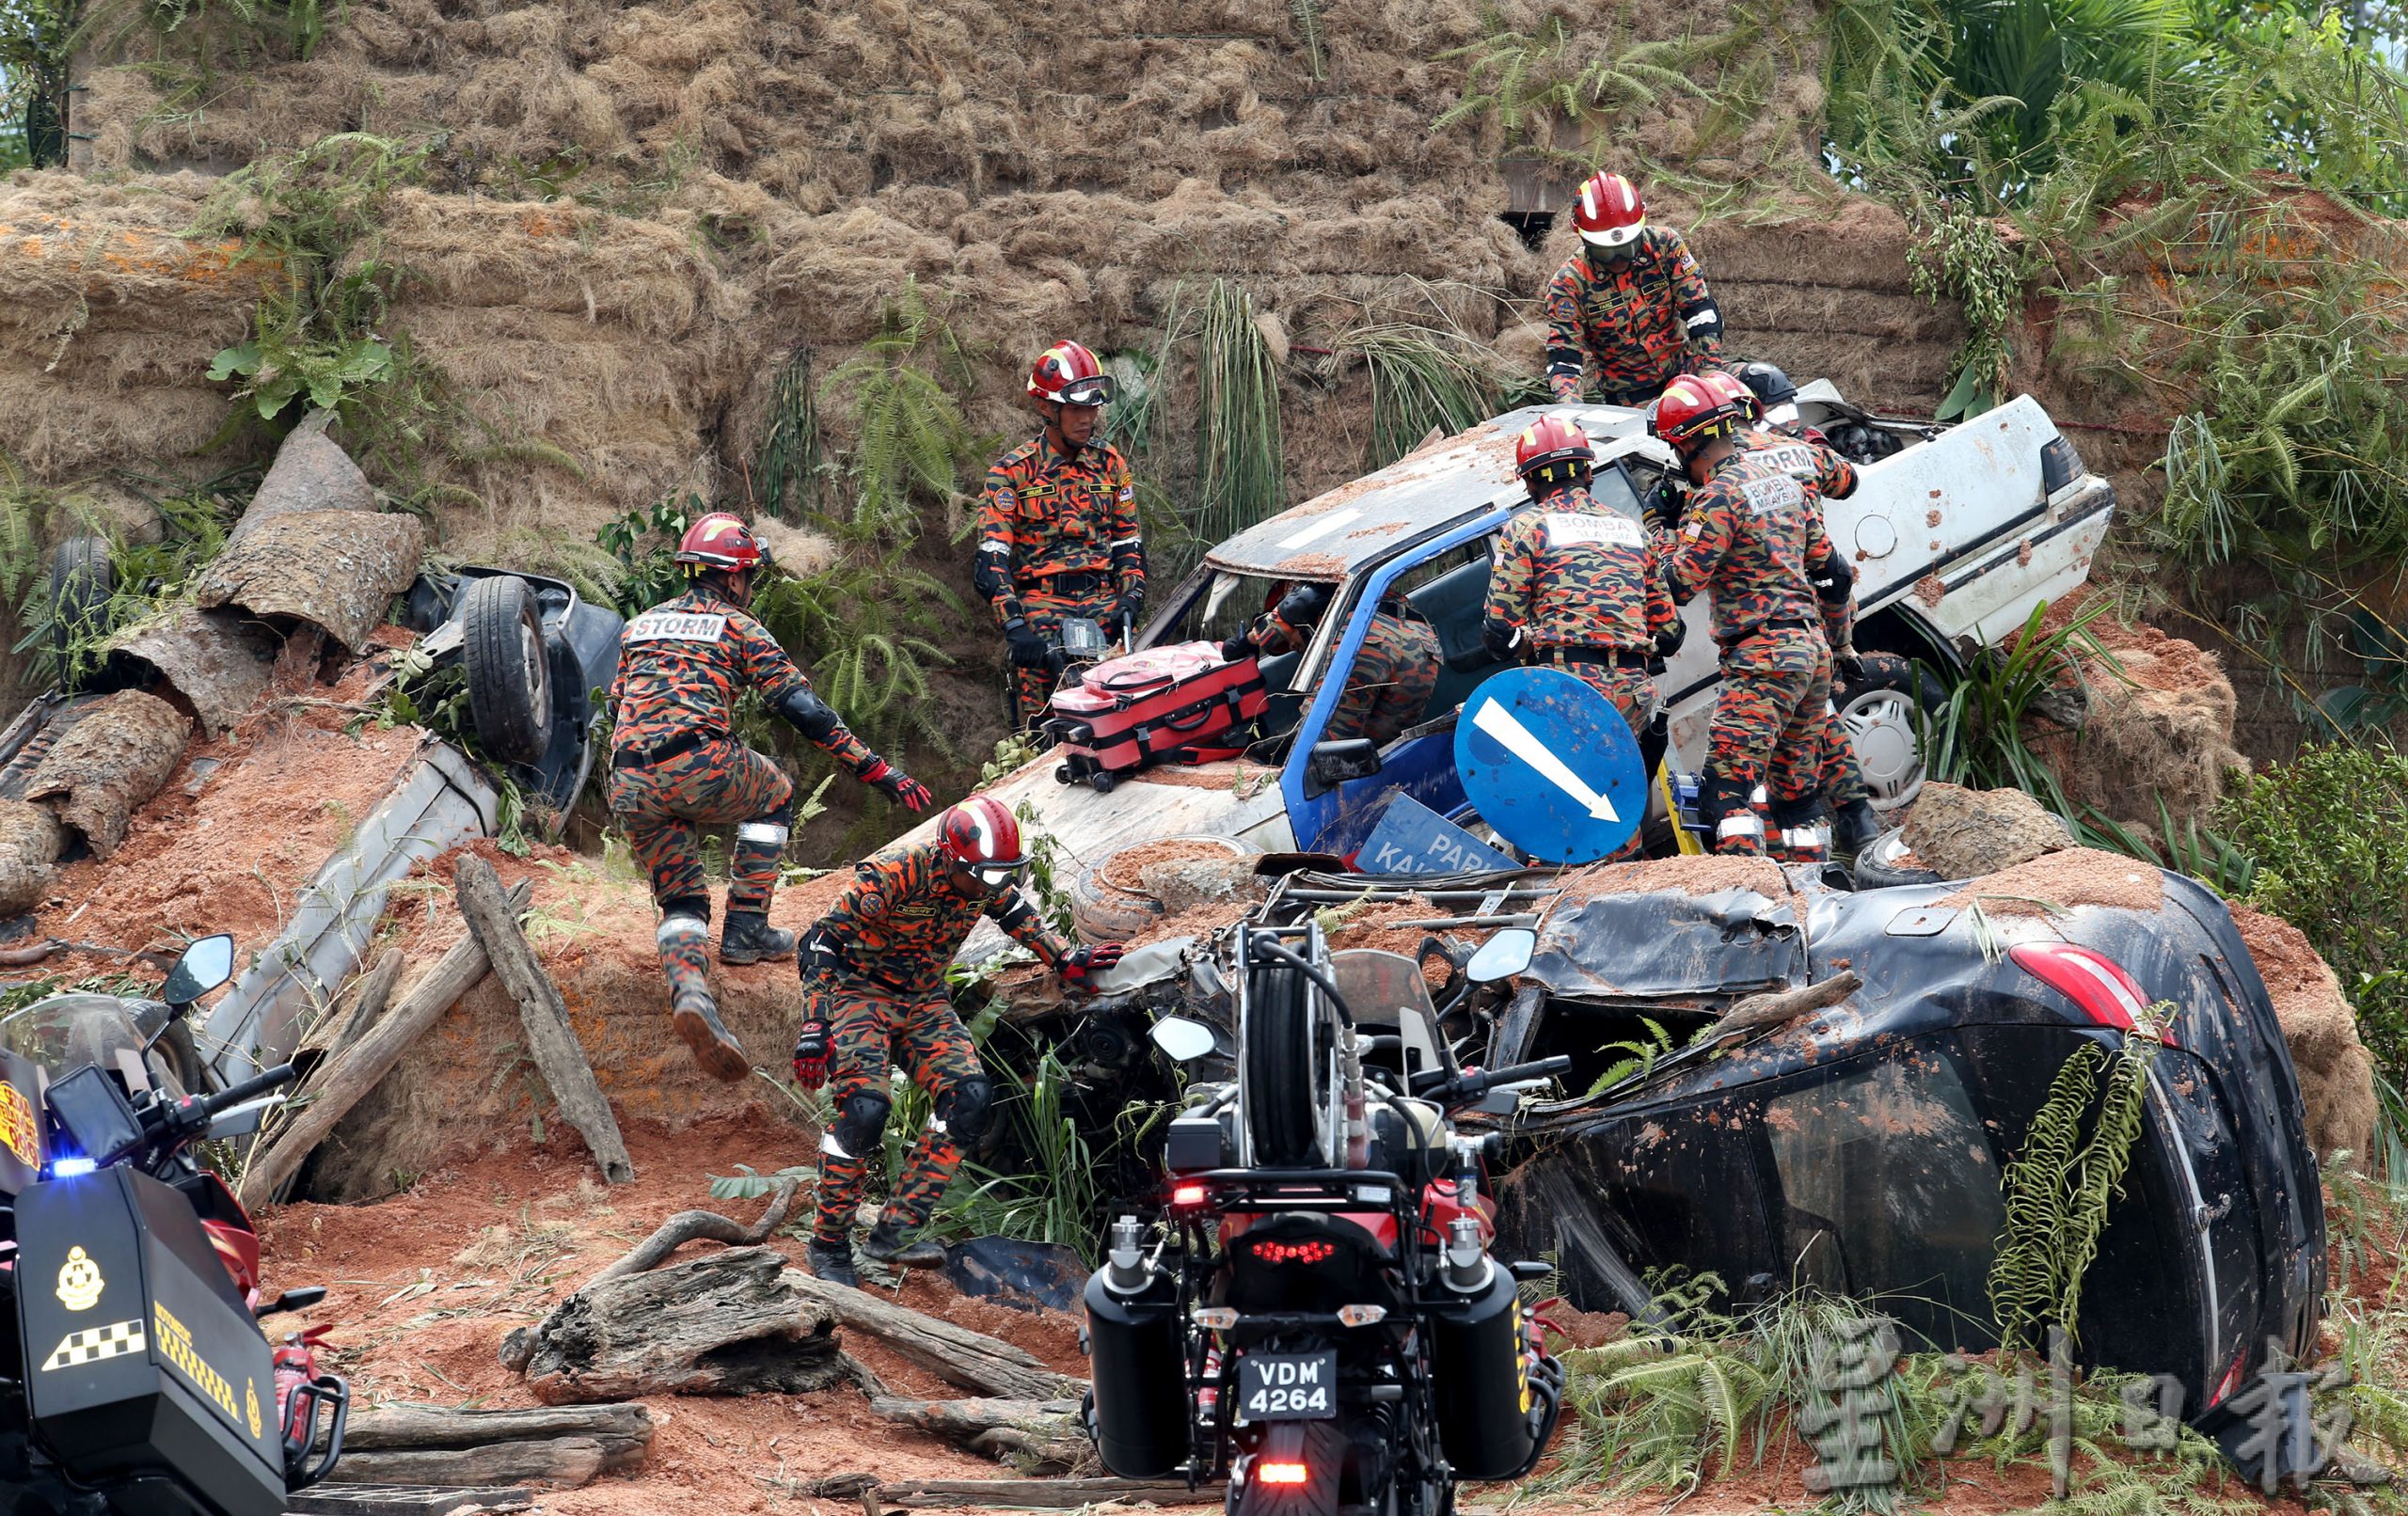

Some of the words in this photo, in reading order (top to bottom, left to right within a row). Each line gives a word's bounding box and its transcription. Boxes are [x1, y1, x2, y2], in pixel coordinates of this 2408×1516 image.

[1750, 478, 1793, 498] BOMBA
[1557, 516, 1631, 532] BOMBA
[635, 616, 721, 637] STORM
[1427, 833, 1491, 873] PAR
[1259, 1361, 1318, 1385] VDM
[1248, 1386, 1327, 1413] 4264
